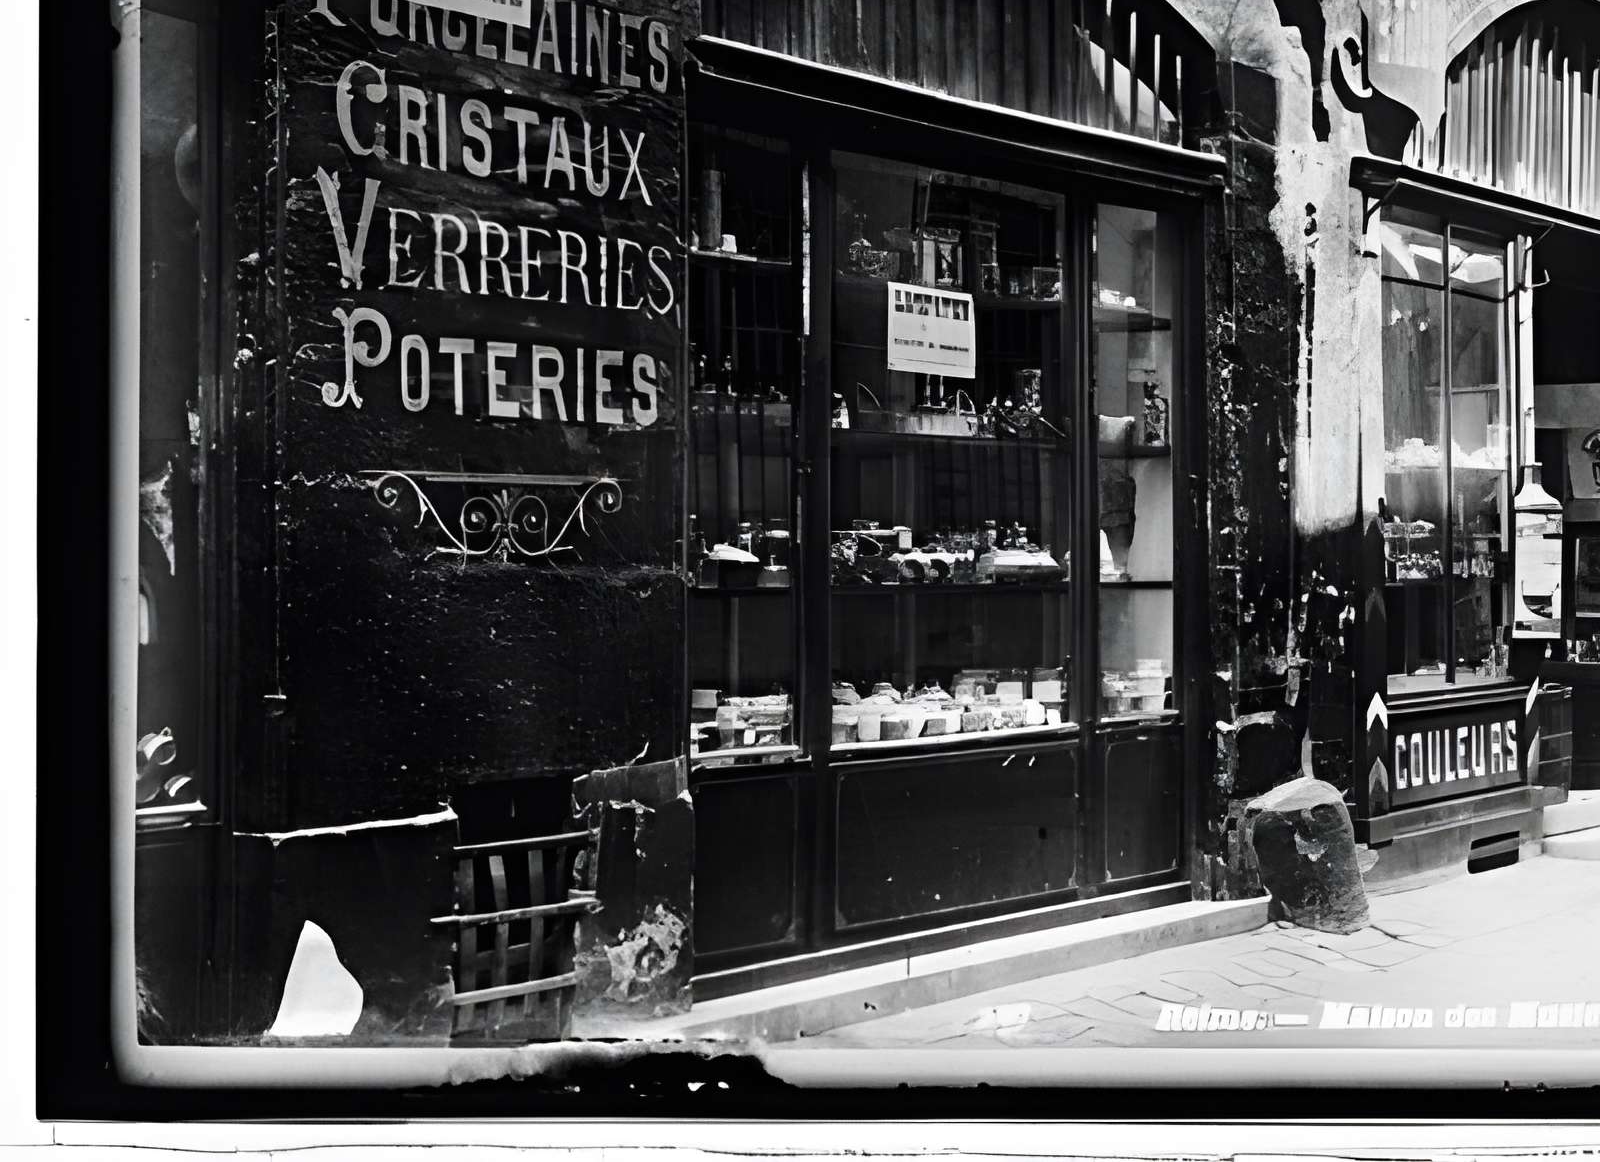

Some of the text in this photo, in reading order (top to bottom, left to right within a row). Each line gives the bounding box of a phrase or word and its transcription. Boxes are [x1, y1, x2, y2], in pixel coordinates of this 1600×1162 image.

[335, 59, 654, 207] CRISTAUX
[315, 165, 675, 316] VERRERIES
[321, 306, 659, 427] POTERIES
[1394, 719, 1518, 790] COULEURS
